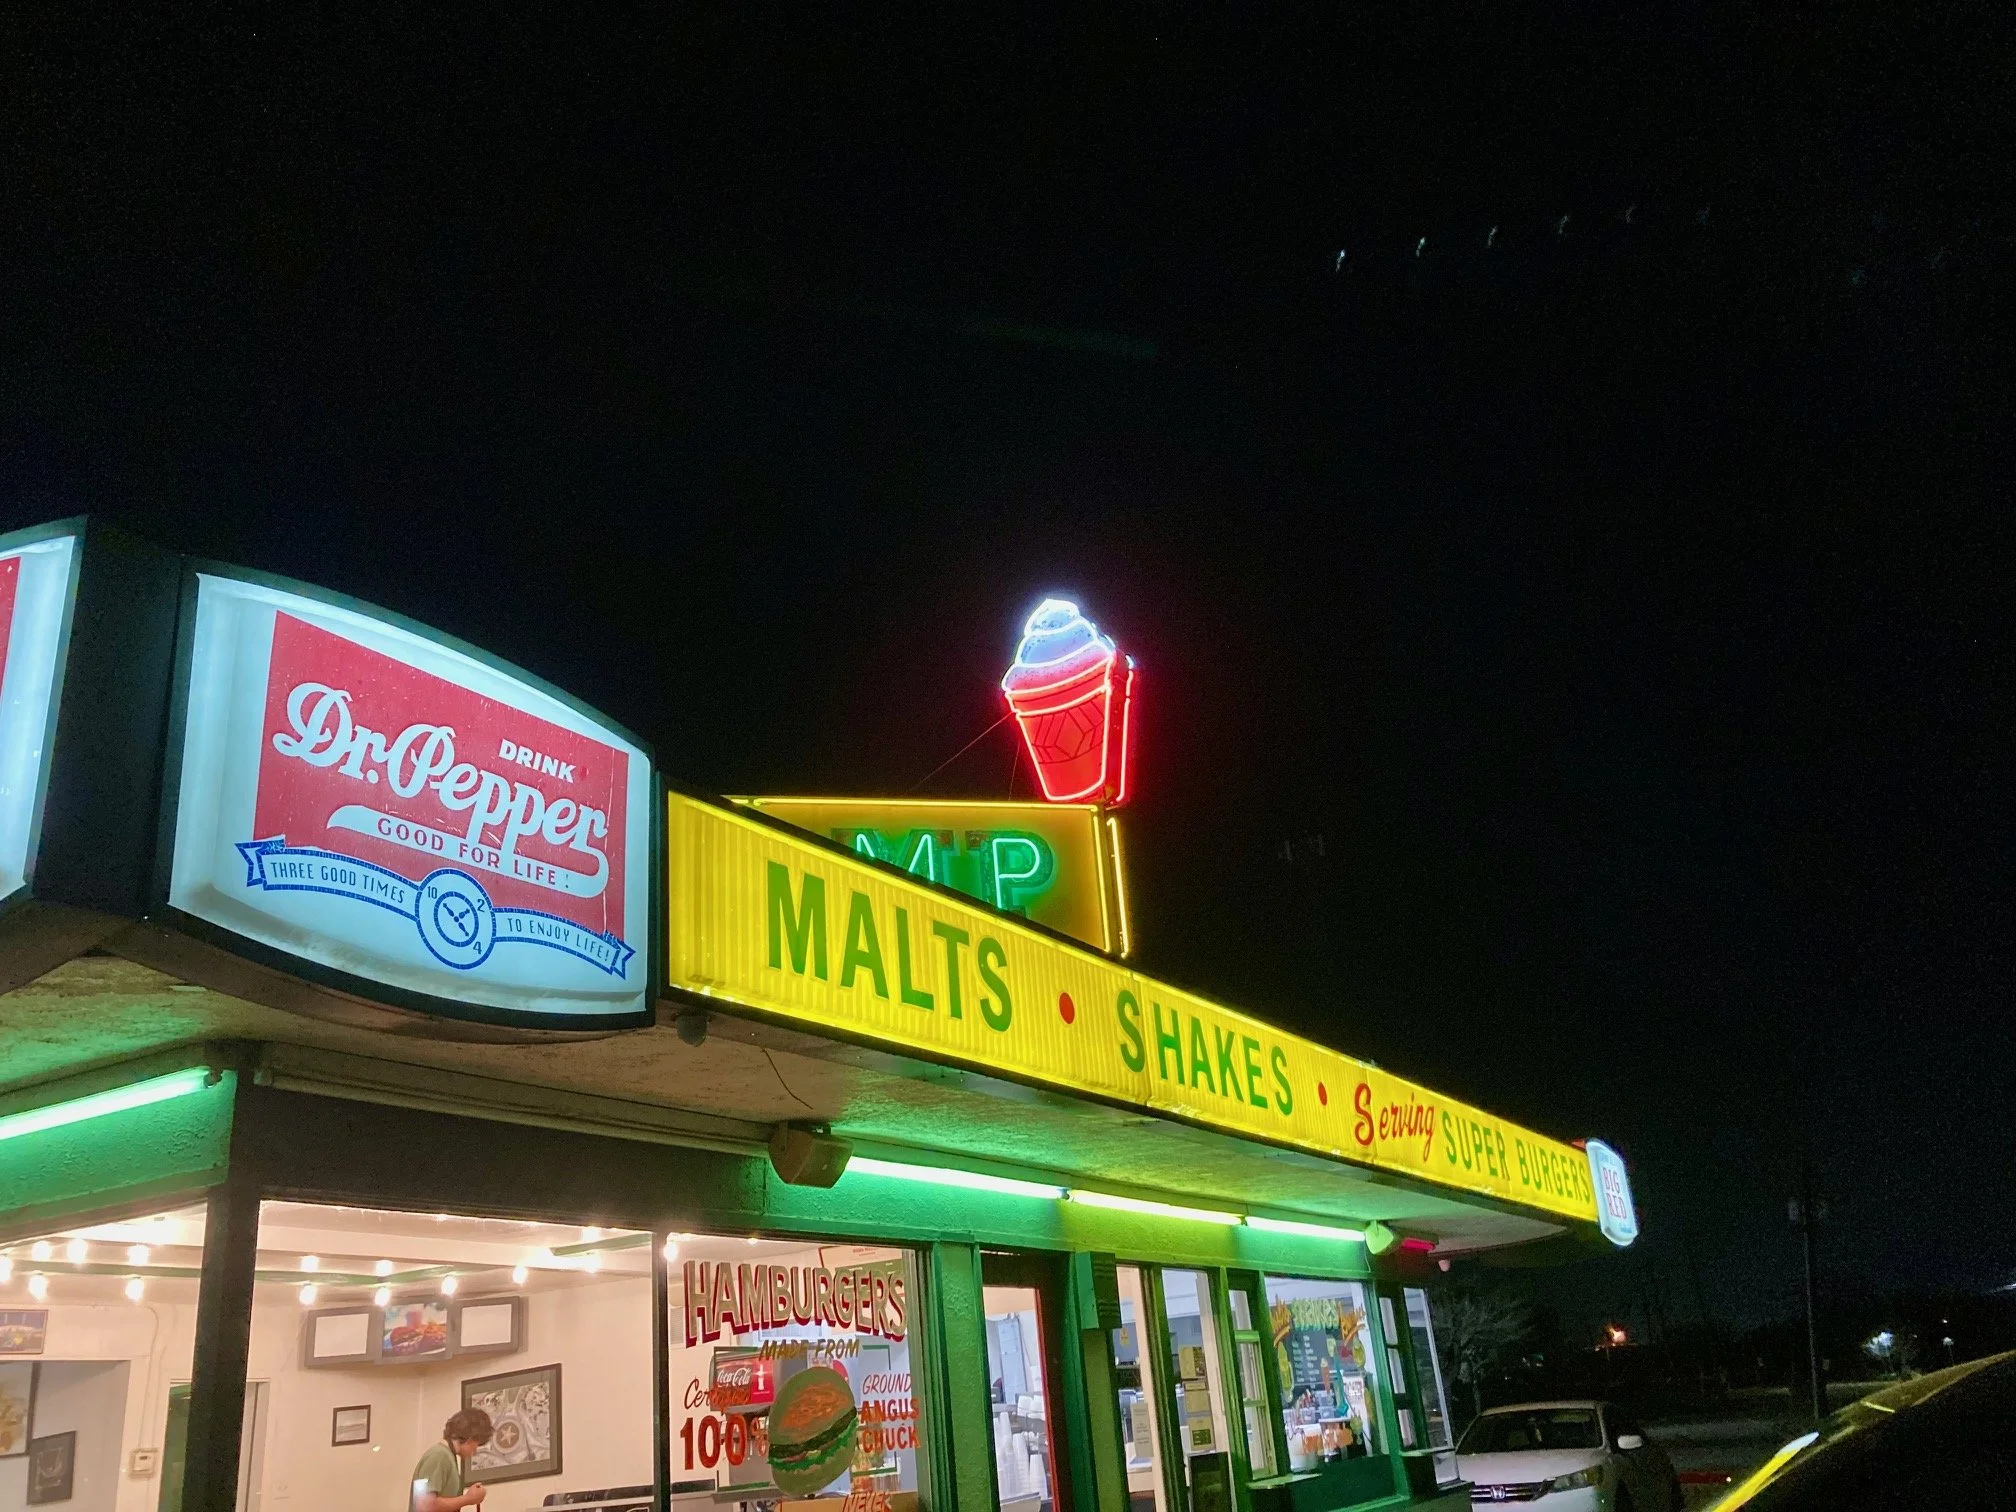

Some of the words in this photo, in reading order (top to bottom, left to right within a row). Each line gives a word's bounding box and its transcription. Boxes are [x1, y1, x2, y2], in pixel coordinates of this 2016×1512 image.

[273, 683, 388, 784] Dr.
[387, 724, 607, 850] Pepper
[499, 739, 576, 784] DRINK
[377, 817, 444, 851] GOOD
[459, 844, 500, 869] FOR
[270, 861, 314, 880] THREE
[320, 865, 357, 886] GOOD
[362, 874, 405, 904] TIMES
[427, 885, 438, 900] 10
[476, 898, 486, 913] 2
[472, 941, 482, 955] 4
[508, 917, 522, 933] TO
[529, 920, 570, 943] ENJOY
[576, 933, 610, 962] LIFE!
[766, 860, 1013, 1032] MALTS
[1116, 989, 1294, 1117] SHAKES
[1354, 1083, 1435, 1162] Serving
[1442, 1110, 1511, 1181] SUPER
[1517, 1138, 1591, 1205] BURGERS
[1602, 1167, 1620, 1194] BIG
[1606, 1193, 1627, 1219] RED
[683, 1259, 908, 1349] HAMBURGERS
[758, 1338, 810, 1361] MADE
[815, 1338, 860, 1360] FROM
[862, 1373, 912, 1395] GROUND
[860, 1398, 920, 1424] ANGUS
[862, 1425, 921, 1453] CHUCK
